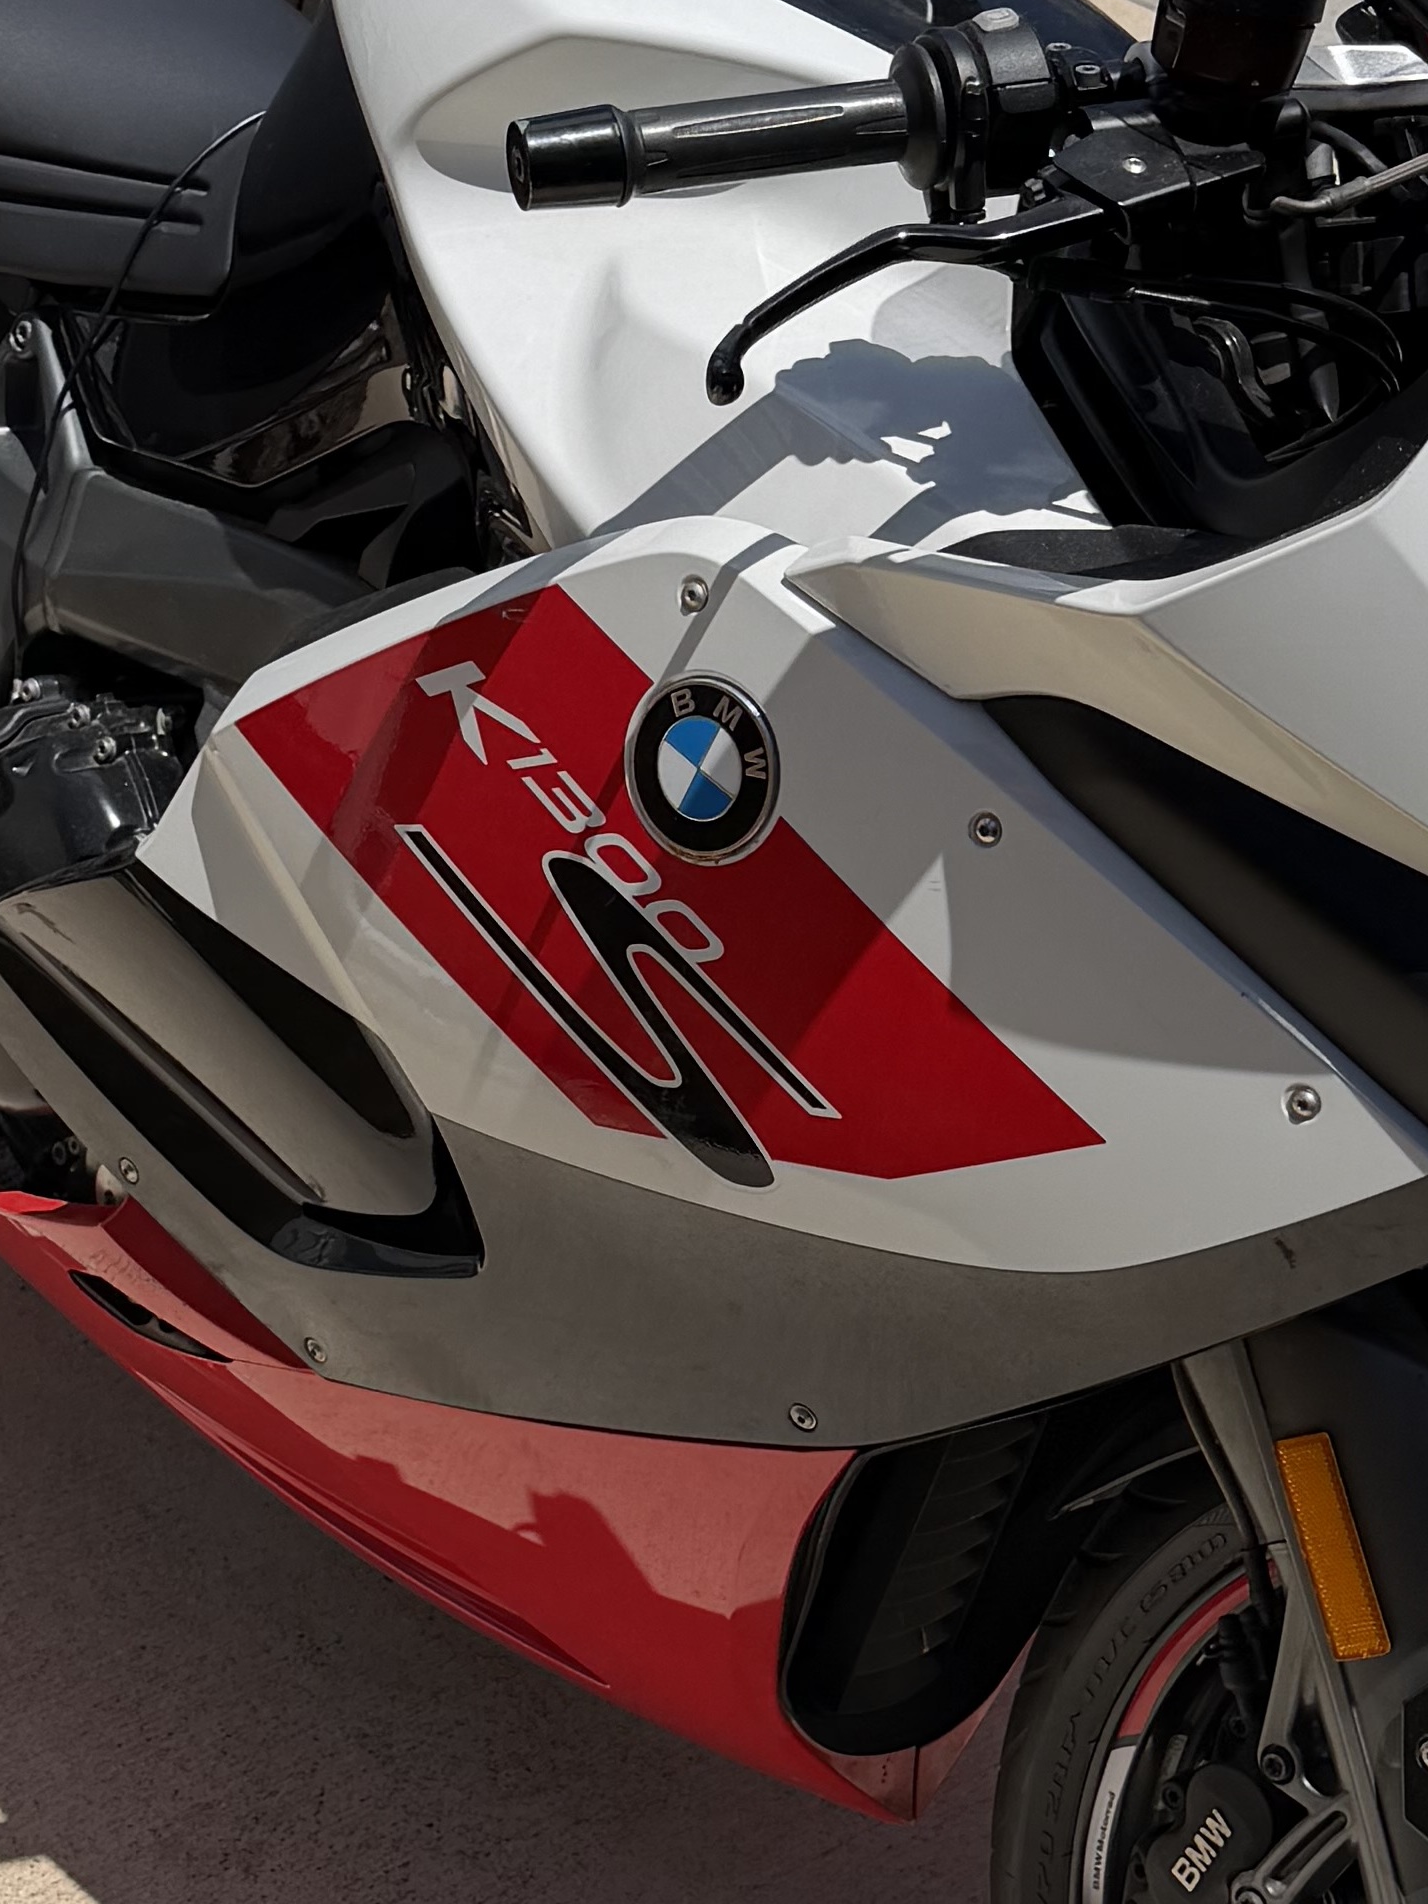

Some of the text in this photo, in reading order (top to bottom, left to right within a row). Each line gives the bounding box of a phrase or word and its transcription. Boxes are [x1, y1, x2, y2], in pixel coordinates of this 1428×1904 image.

[670, 688, 769, 781] BMW
[415, 661, 724, 963] K1300
[1170, 1805, 1235, 1894] BMW
